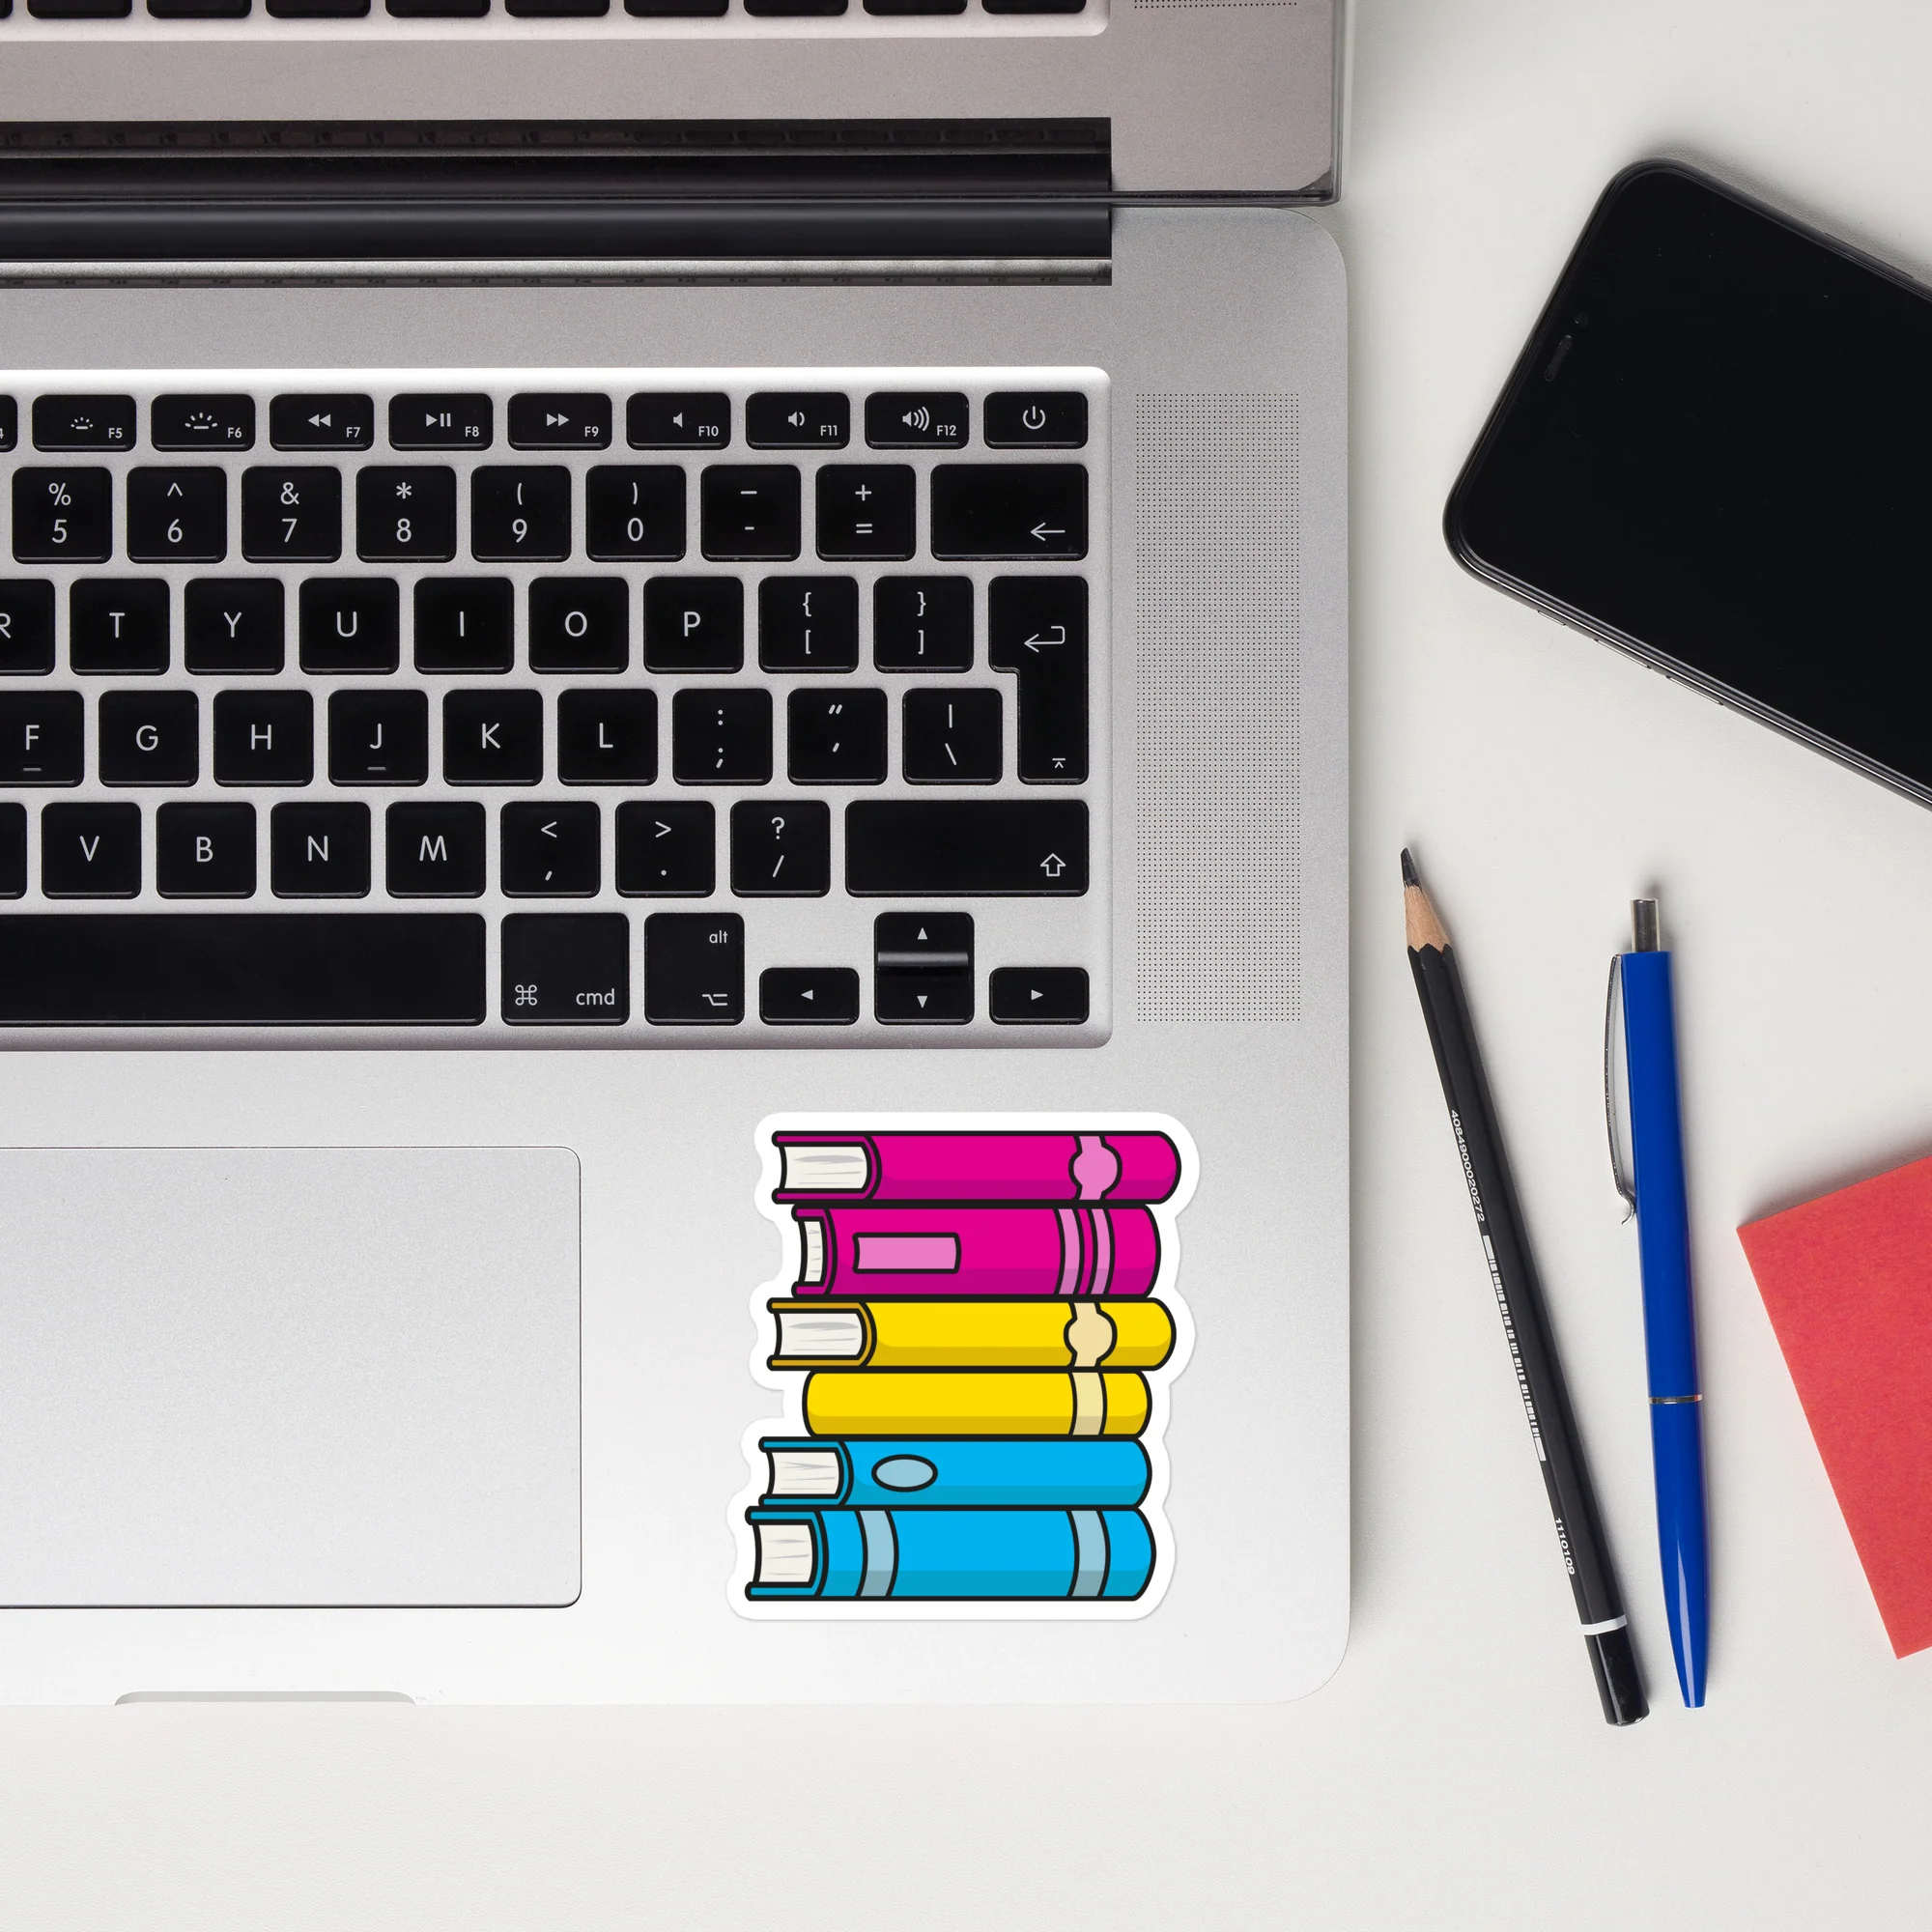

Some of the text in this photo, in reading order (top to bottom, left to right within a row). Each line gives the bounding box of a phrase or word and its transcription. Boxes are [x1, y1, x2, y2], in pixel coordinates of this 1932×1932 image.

[108, 427, 123, 440] F5
[227, 427, 242, 439] F6
[346, 426, 361, 438] F7
[465, 426, 480, 438] F8
[584, 425, 599, 438] F9
[698, 425, 720, 438] F10
[820, 424, 838, 437] F11
[936, 424, 957, 437] F12
[48, 482, 71, 506] %
[280, 481, 299, 505] &
[855, 484, 872, 501] +
[51, 519, 68, 544] 5
[167, 518, 184, 543] 6
[281, 518, 298, 543] 7
[396, 518, 412, 543] 8
[512, 518, 527, 543] 9
[855, 523, 873, 534] =
[0, 612, 12, 639] R
[108, 611, 126, 639] T
[223, 611, 242, 639] Y
[336, 611, 357, 638] U
[683, 611, 701, 638] P
[25, 724, 40, 751] F
[135, 724, 158, 752] G
[250, 724, 272, 751] H
[369, 723, 383, 750] J
[481, 723, 501, 750] K
[599, 722, 614, 749] L
[771, 816, 785, 840] ?
[79, 835, 100, 862] V
[196, 836, 213, 863] B
[307, 835, 328, 862] N
[419, 835, 447, 862] M
[708, 929, 728, 944] alt
[576, 987, 615, 1006] cmd
[1451, 1109, 1485, 1222] 4084900020272
[1555, 1517, 1576, 1576] 1110109
